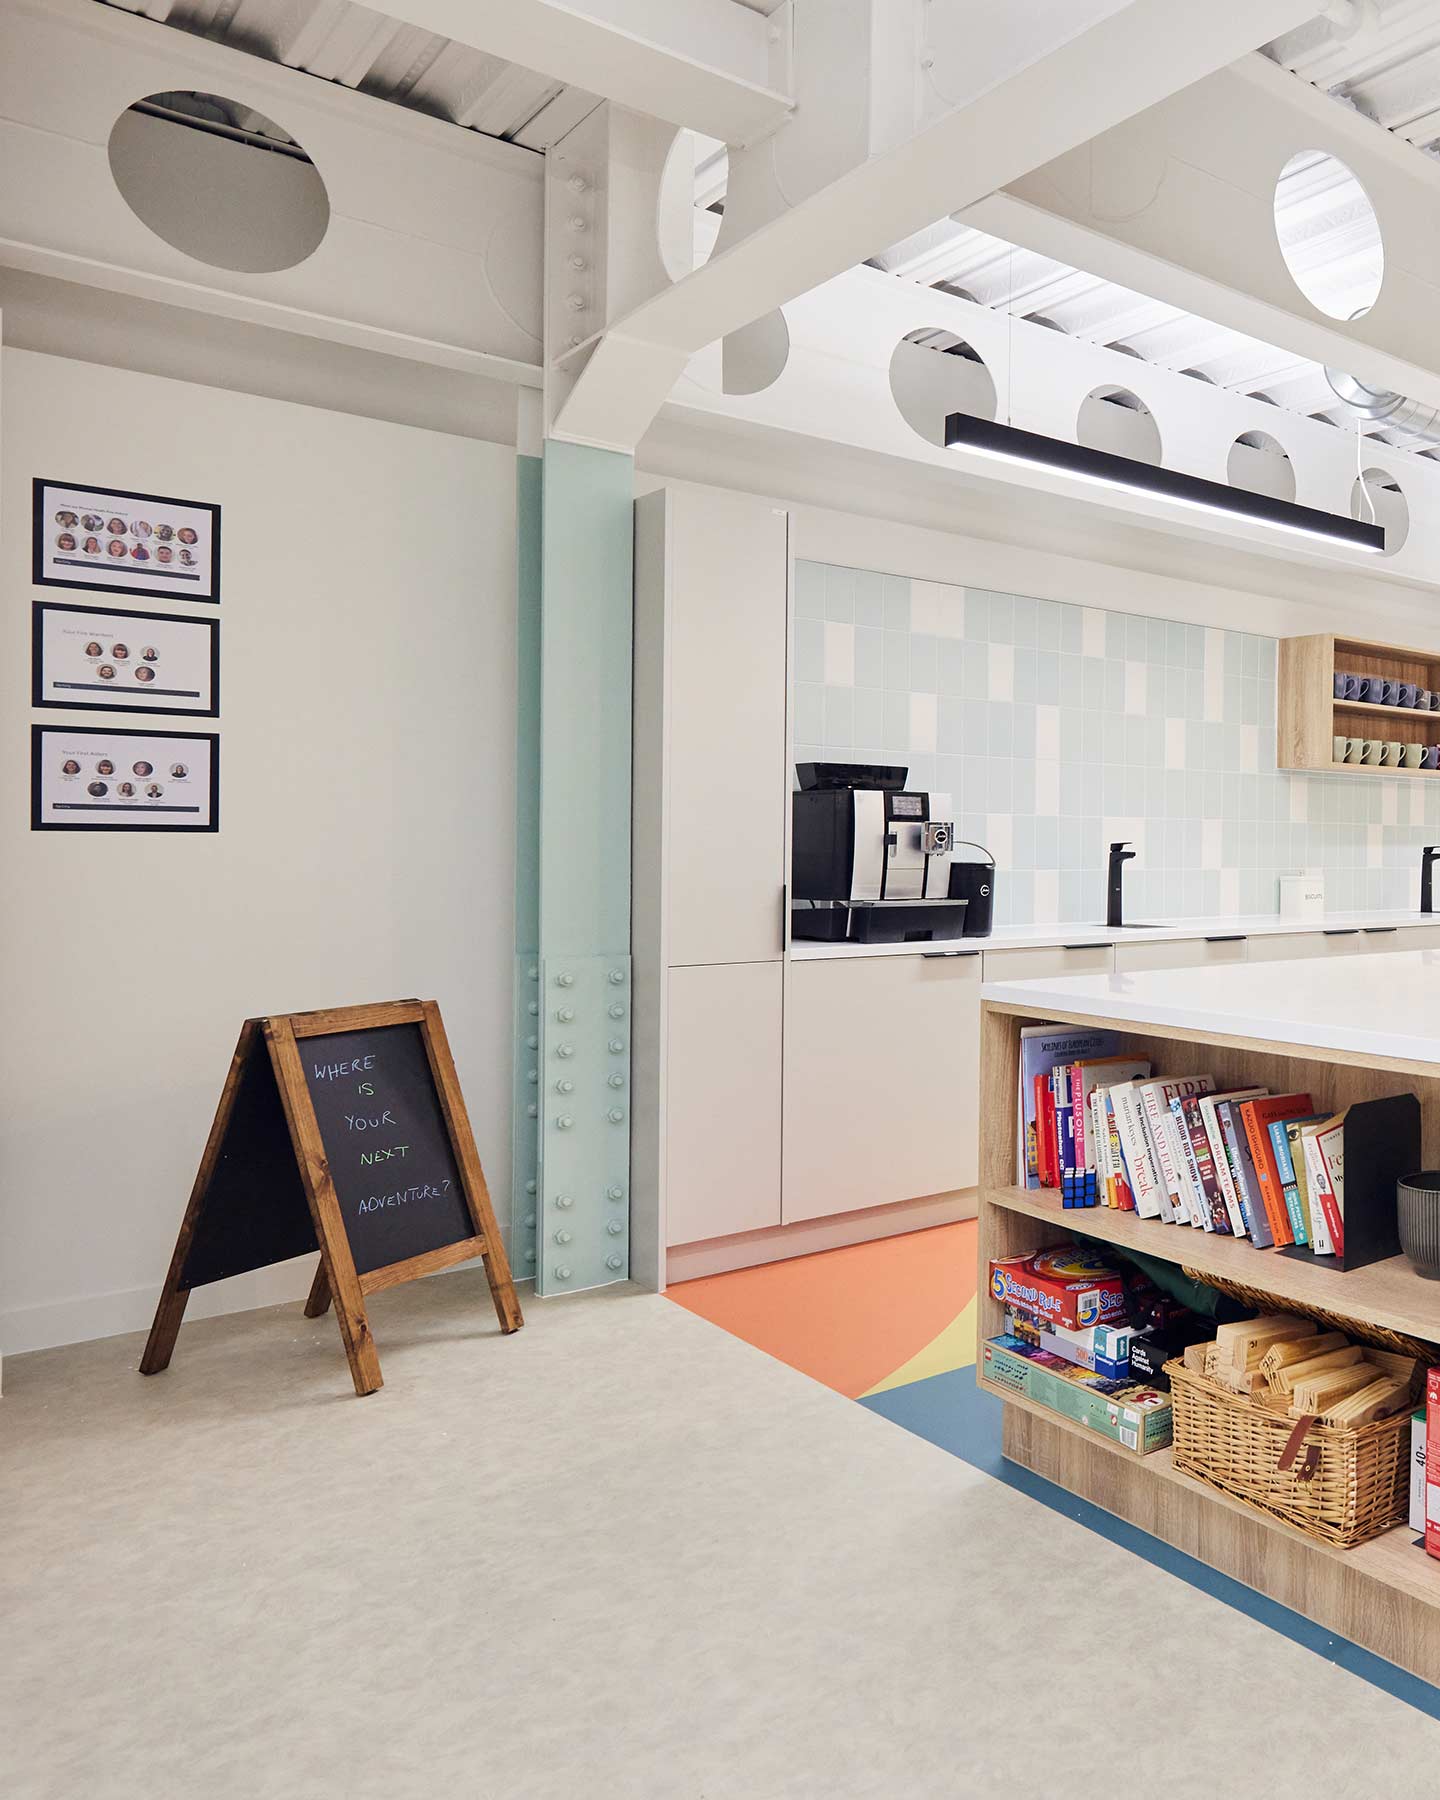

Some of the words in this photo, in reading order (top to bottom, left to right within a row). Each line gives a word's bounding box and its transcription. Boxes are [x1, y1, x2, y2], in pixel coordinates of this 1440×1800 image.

[314, 1055, 376, 1081] WHERE
[358, 1083, 375, 1096] IS
[344, 1110, 396, 1131] YOUR
[1076, 1118, 1084, 1143] ONE
[1176, 1116, 1187, 1145] BLOOD
[1145, 1092, 1159, 1121] FIRE
[1153, 1123, 1166, 1151] AND
[1160, 1152, 1176, 1184] FURY
[1183, 1142, 1192, 1158] RED
[1244, 1108, 1254, 1134] KAZUO
[1250, 1134, 1264, 1170] ISHIGURO
[360, 1146, 409, 1165] NEXT
[1140, 1117, 1150, 1148] Inclusion
[1147, 1147, 1159, 1185] Imperative
[1134, 1154, 1153, 1197] break
[1187, 1158, 1199, 1182] SNOW
[1214, 1144, 1226, 1178] DREAM
[1224, 1180, 1235, 1209] TEAMS
[358, 1180, 450, 1215] ADVENTURE?
[992, 1268, 1005, 1298] 5
[1005, 1273, 1038, 1302] SECOND
[1039, 1290, 1062, 1312] RULE
[1100, 1290, 1123, 1311] SEC
[1132, 1345, 1146, 1357] Cards
[1132, 1353, 1150, 1366] Against
[1132, 1360, 1154, 1375] Humanity
[1416, 1446, 1426, 1467] 40+
